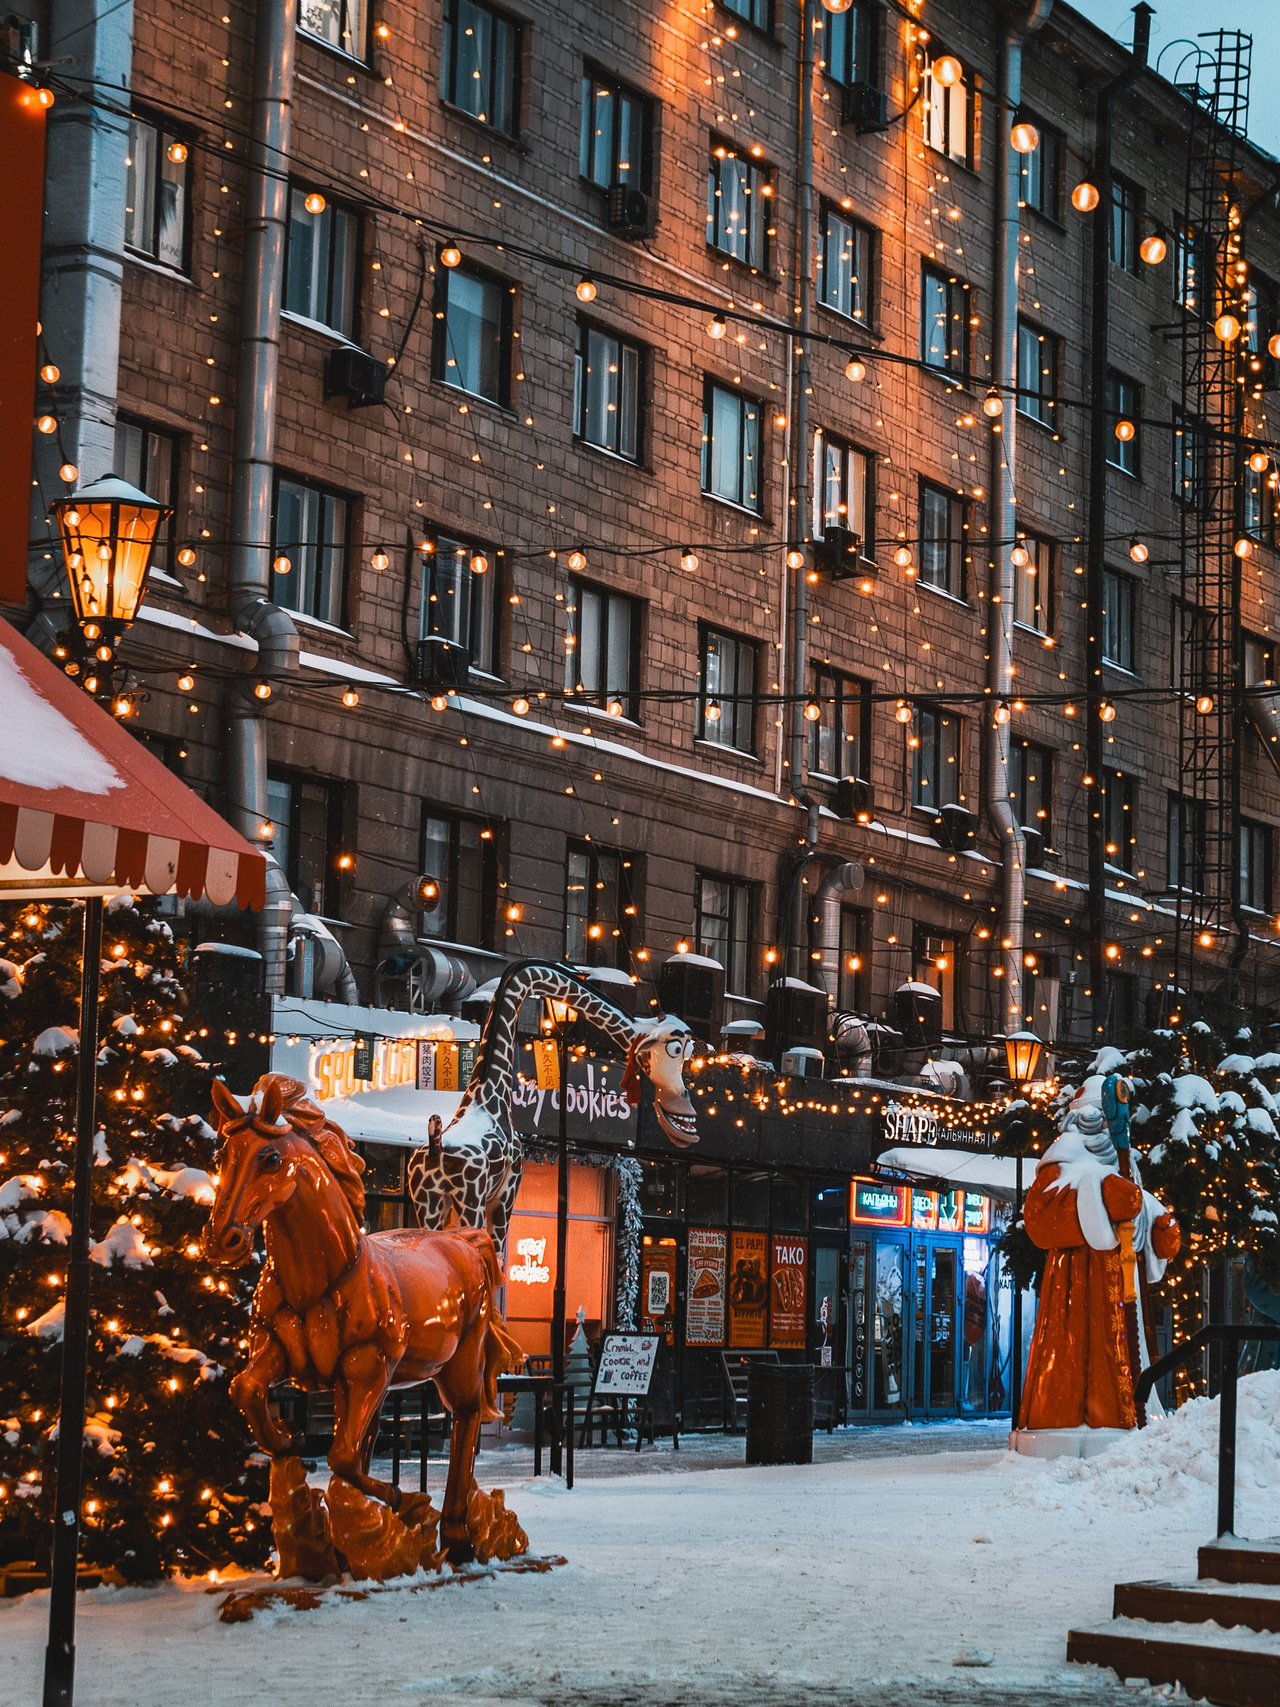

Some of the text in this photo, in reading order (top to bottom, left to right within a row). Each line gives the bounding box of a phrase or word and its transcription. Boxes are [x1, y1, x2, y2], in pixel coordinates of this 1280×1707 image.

[421, 1044, 432, 1088] 猪肉饺子
[442, 1045, 453, 1089] 好久不见
[885, 1112, 937, 1146] SHAPE
[937, 1127, 985, 1145] КАЛЬЯННАЯ
[862, 1192, 898, 1208] КАЛЬЯНЫ
[913, 1195, 934, 1211] ЗДЕСЬ
[735, 1237, 764, 1250] EL PAPI
[775, 1245, 805, 1266] TAKO
